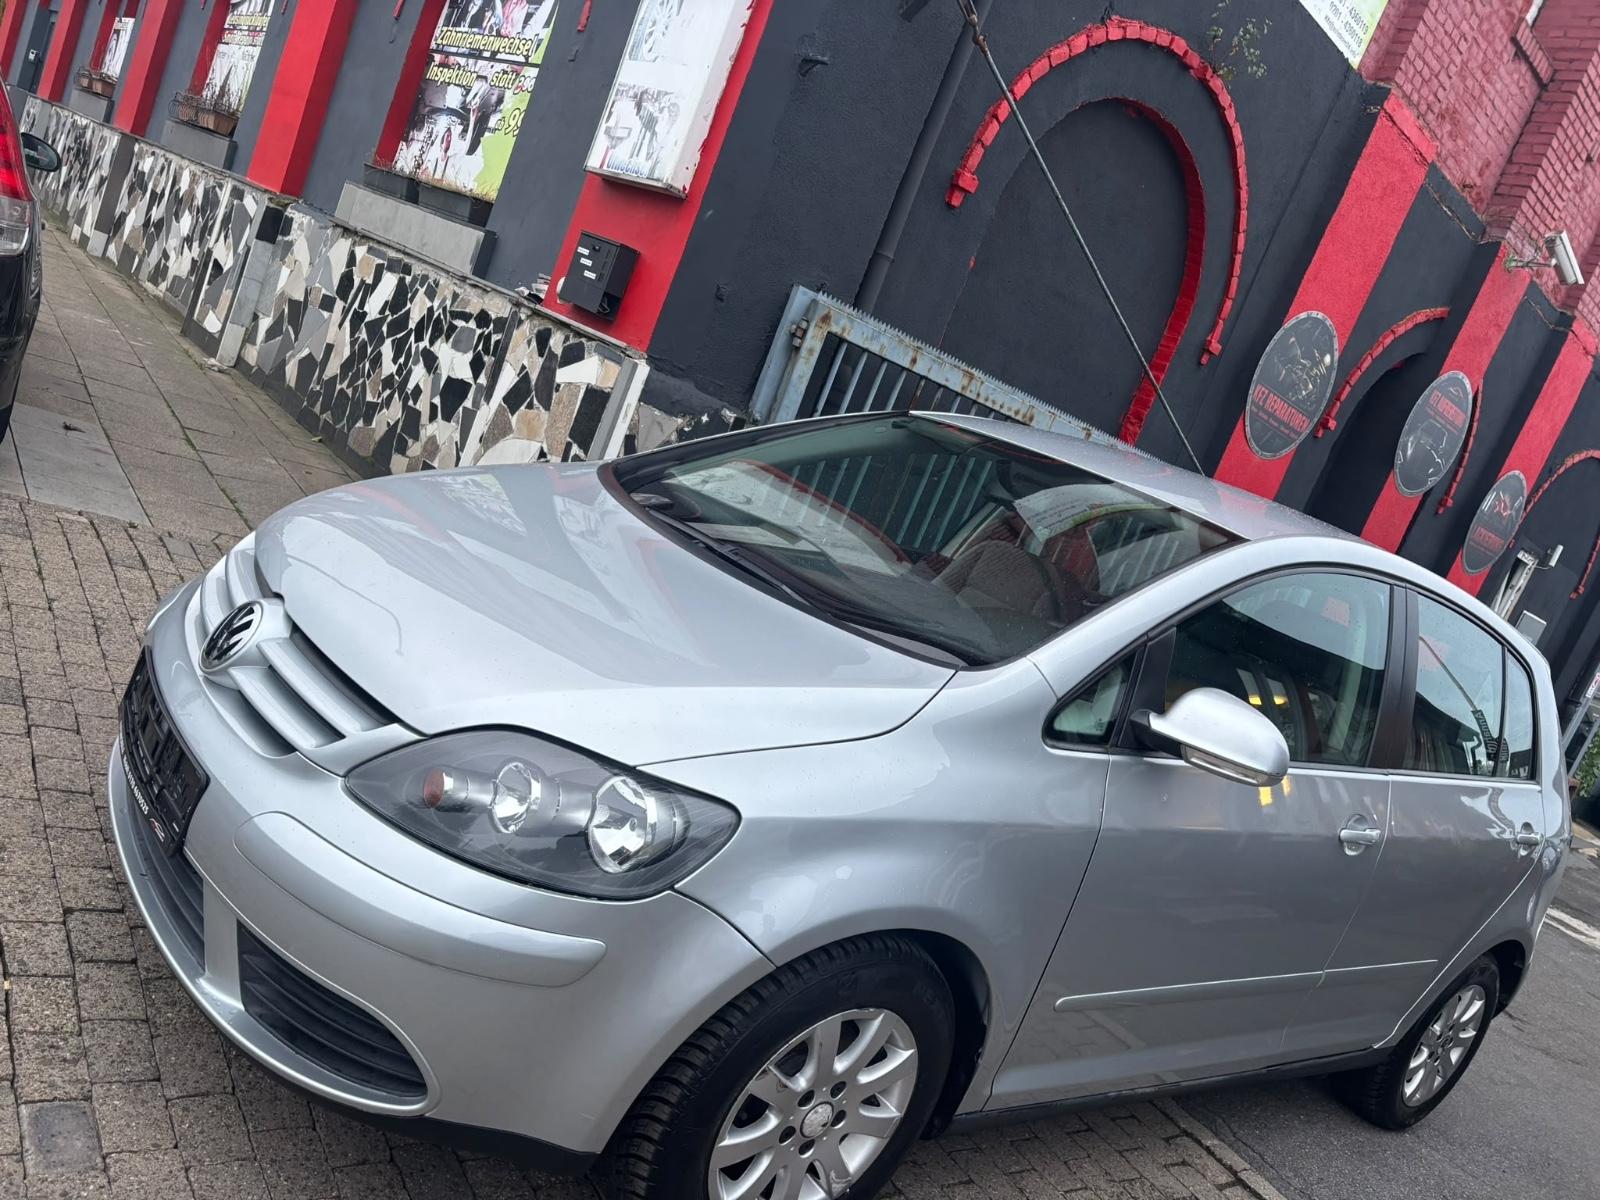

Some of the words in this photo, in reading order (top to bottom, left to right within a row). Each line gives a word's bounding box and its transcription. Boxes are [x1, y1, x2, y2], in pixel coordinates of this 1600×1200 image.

[437, 27, 537, 57] Zahnriemenwechsel
[427, 62, 477, 88] Inspektion
[490, 70, 516, 89] statt
[1253, 383, 1267, 406] KFZ
[1265, 391, 1311, 432] REPARATUREN
